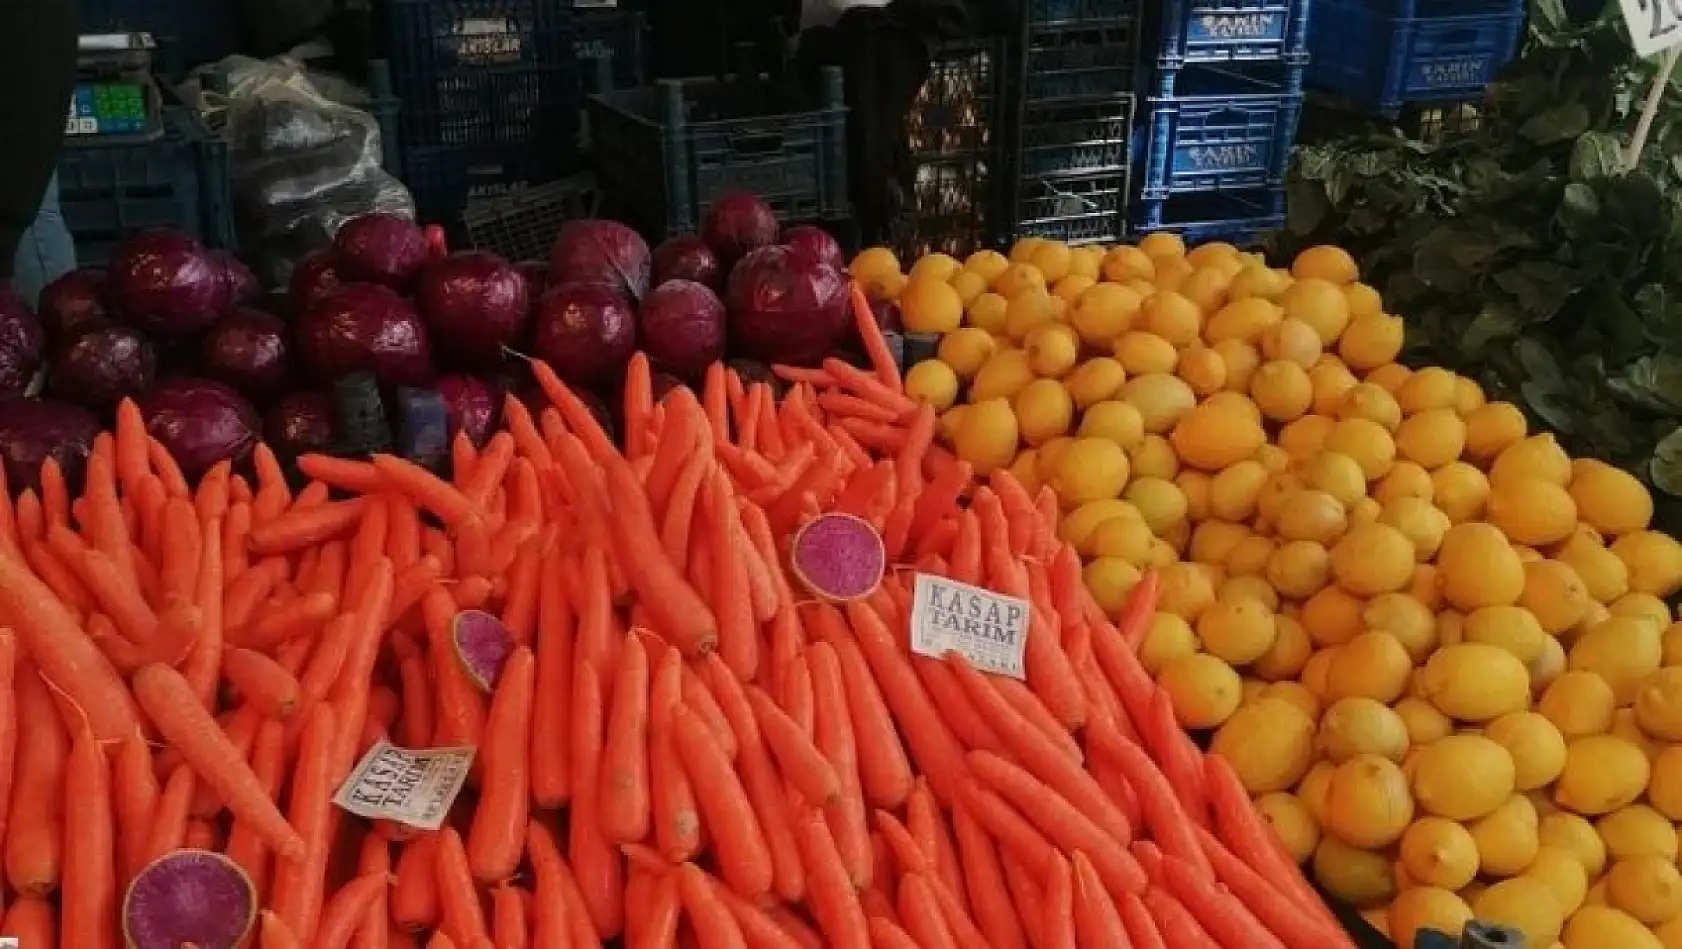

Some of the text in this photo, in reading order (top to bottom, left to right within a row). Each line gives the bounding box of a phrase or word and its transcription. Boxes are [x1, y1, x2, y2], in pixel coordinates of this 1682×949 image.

[930, 583, 1021, 627] KASAP
[930, 609, 1018, 646] TARIM
[352, 749, 402, 806] KASAP
